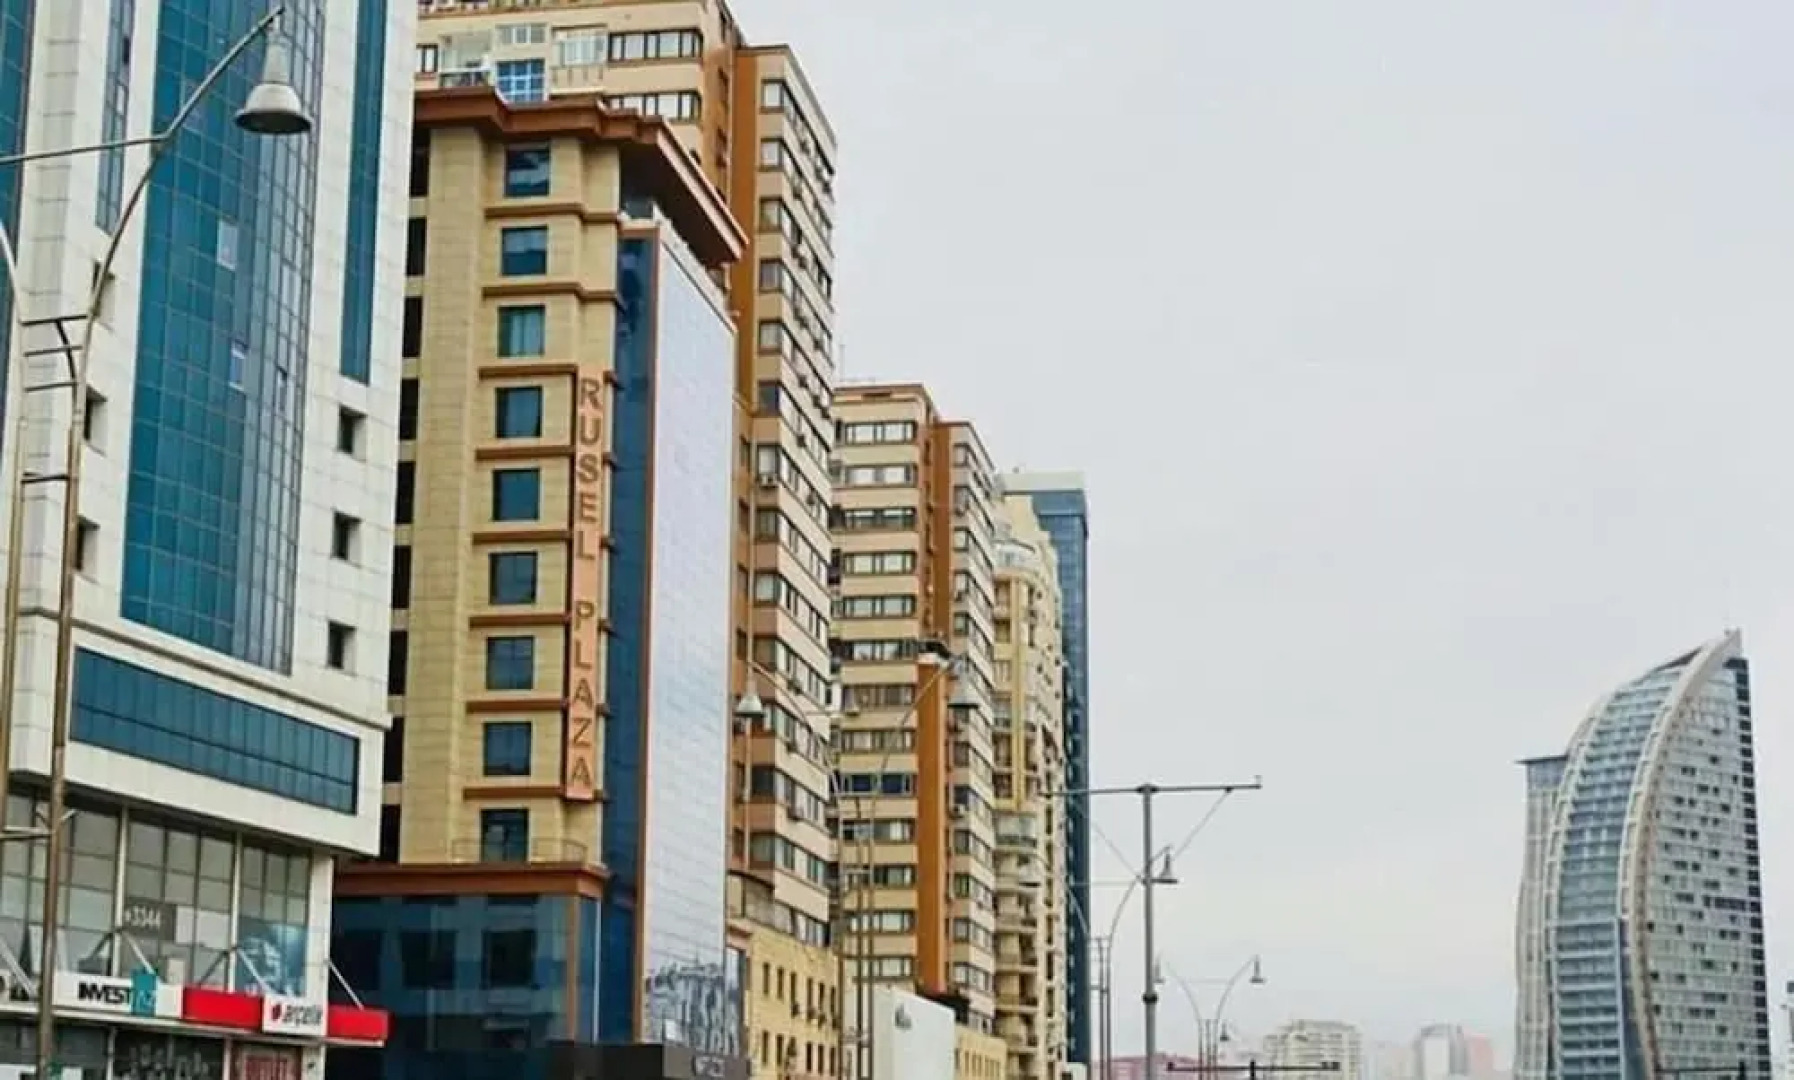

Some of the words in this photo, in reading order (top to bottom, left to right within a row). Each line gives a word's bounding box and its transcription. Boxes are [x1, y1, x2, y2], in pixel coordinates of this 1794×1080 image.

[577, 377, 602, 560] RUSEL
[570, 601, 595, 789] PLAZA
[78, 982, 131, 1005] INVEST
